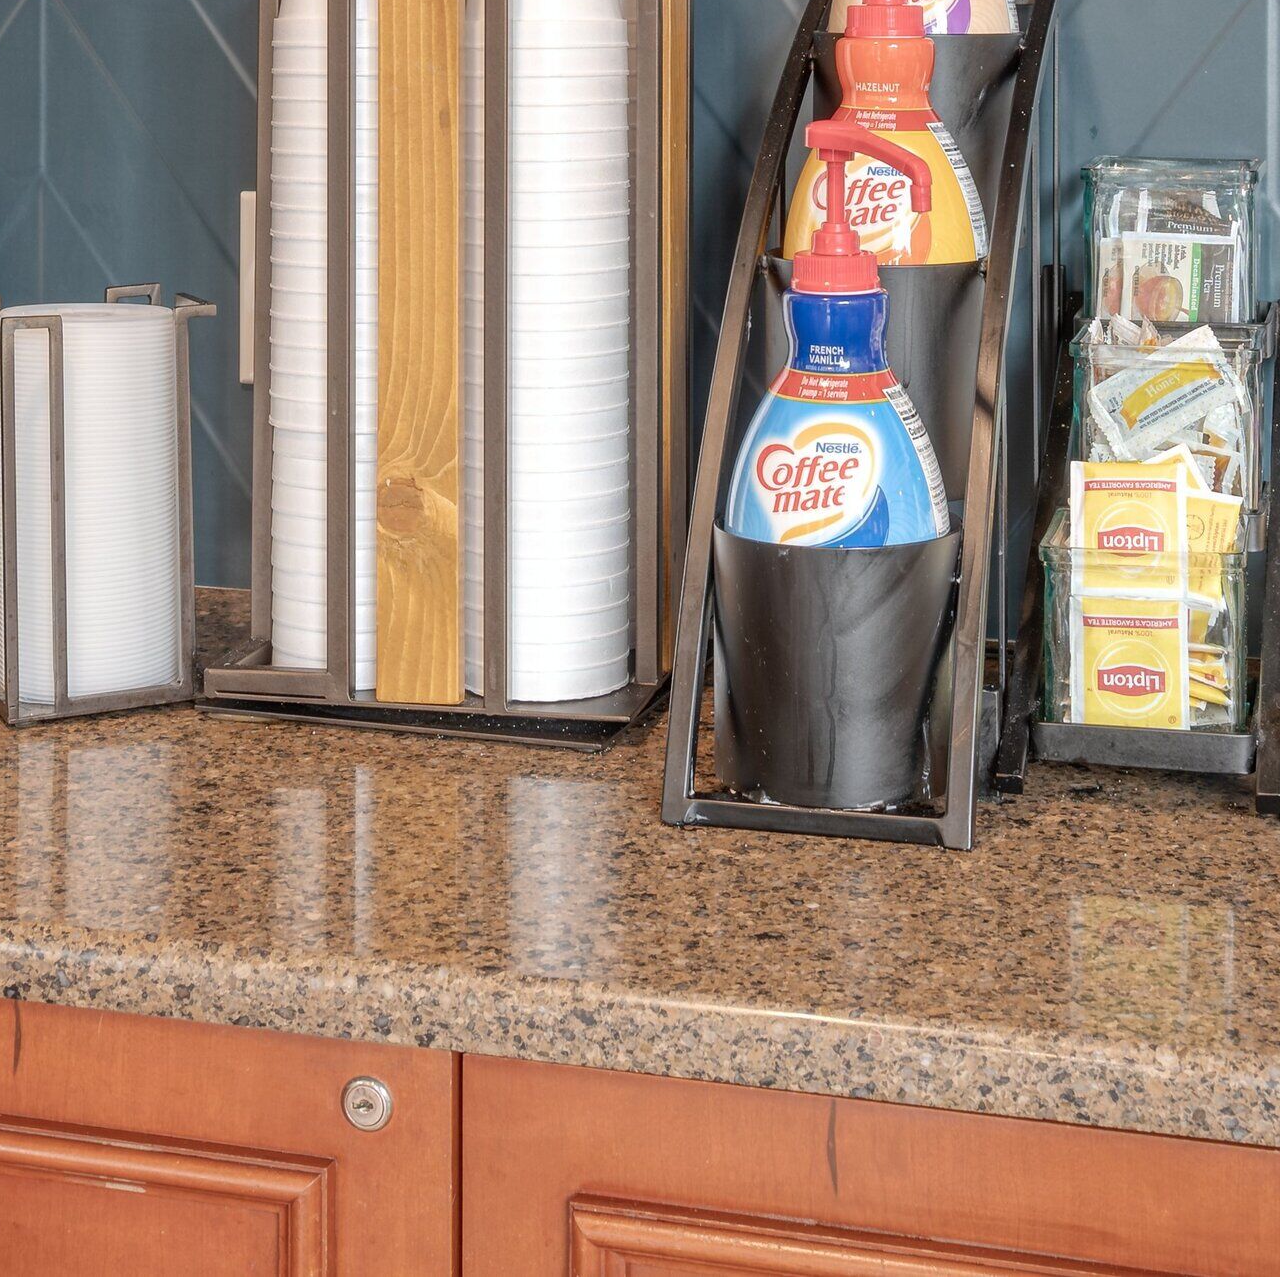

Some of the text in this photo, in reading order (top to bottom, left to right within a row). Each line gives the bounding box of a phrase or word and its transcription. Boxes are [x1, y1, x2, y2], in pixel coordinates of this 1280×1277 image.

[855, 82, 900, 92] HAZELNUT
[856, 111, 897, 121] Do Not Refrigerate
[813, 171, 906, 210] Cffee
[1167, 220, 1213, 233] Premium
[1191, 258, 1200, 311] Decaffeinated
[1203, 279, 1213, 293] Tea
[1213, 264, 1225, 308] Premium
[810, 345, 844, 355] FRENCH
[809, 354, 845, 365] VANILLA
[801, 376, 849, 389] Do Not Refrigerate
[1144, 372, 1182, 397] Honey
[801, 389, 818, 399] pump
[826, 389, 848, 400] serving
[815, 442, 859, 454] Nestlé
[757, 443, 859, 491] Coffee
[1101, 481, 1134, 489] FAVORITE
[772, 485, 846, 513] mate
[1103, 532, 1159, 551] Lipton
[1102, 618, 1135, 626] FAVORITE
[1135, 619, 1173, 627] AMERICA'S
[1103, 671, 1160, 691] Lipton
